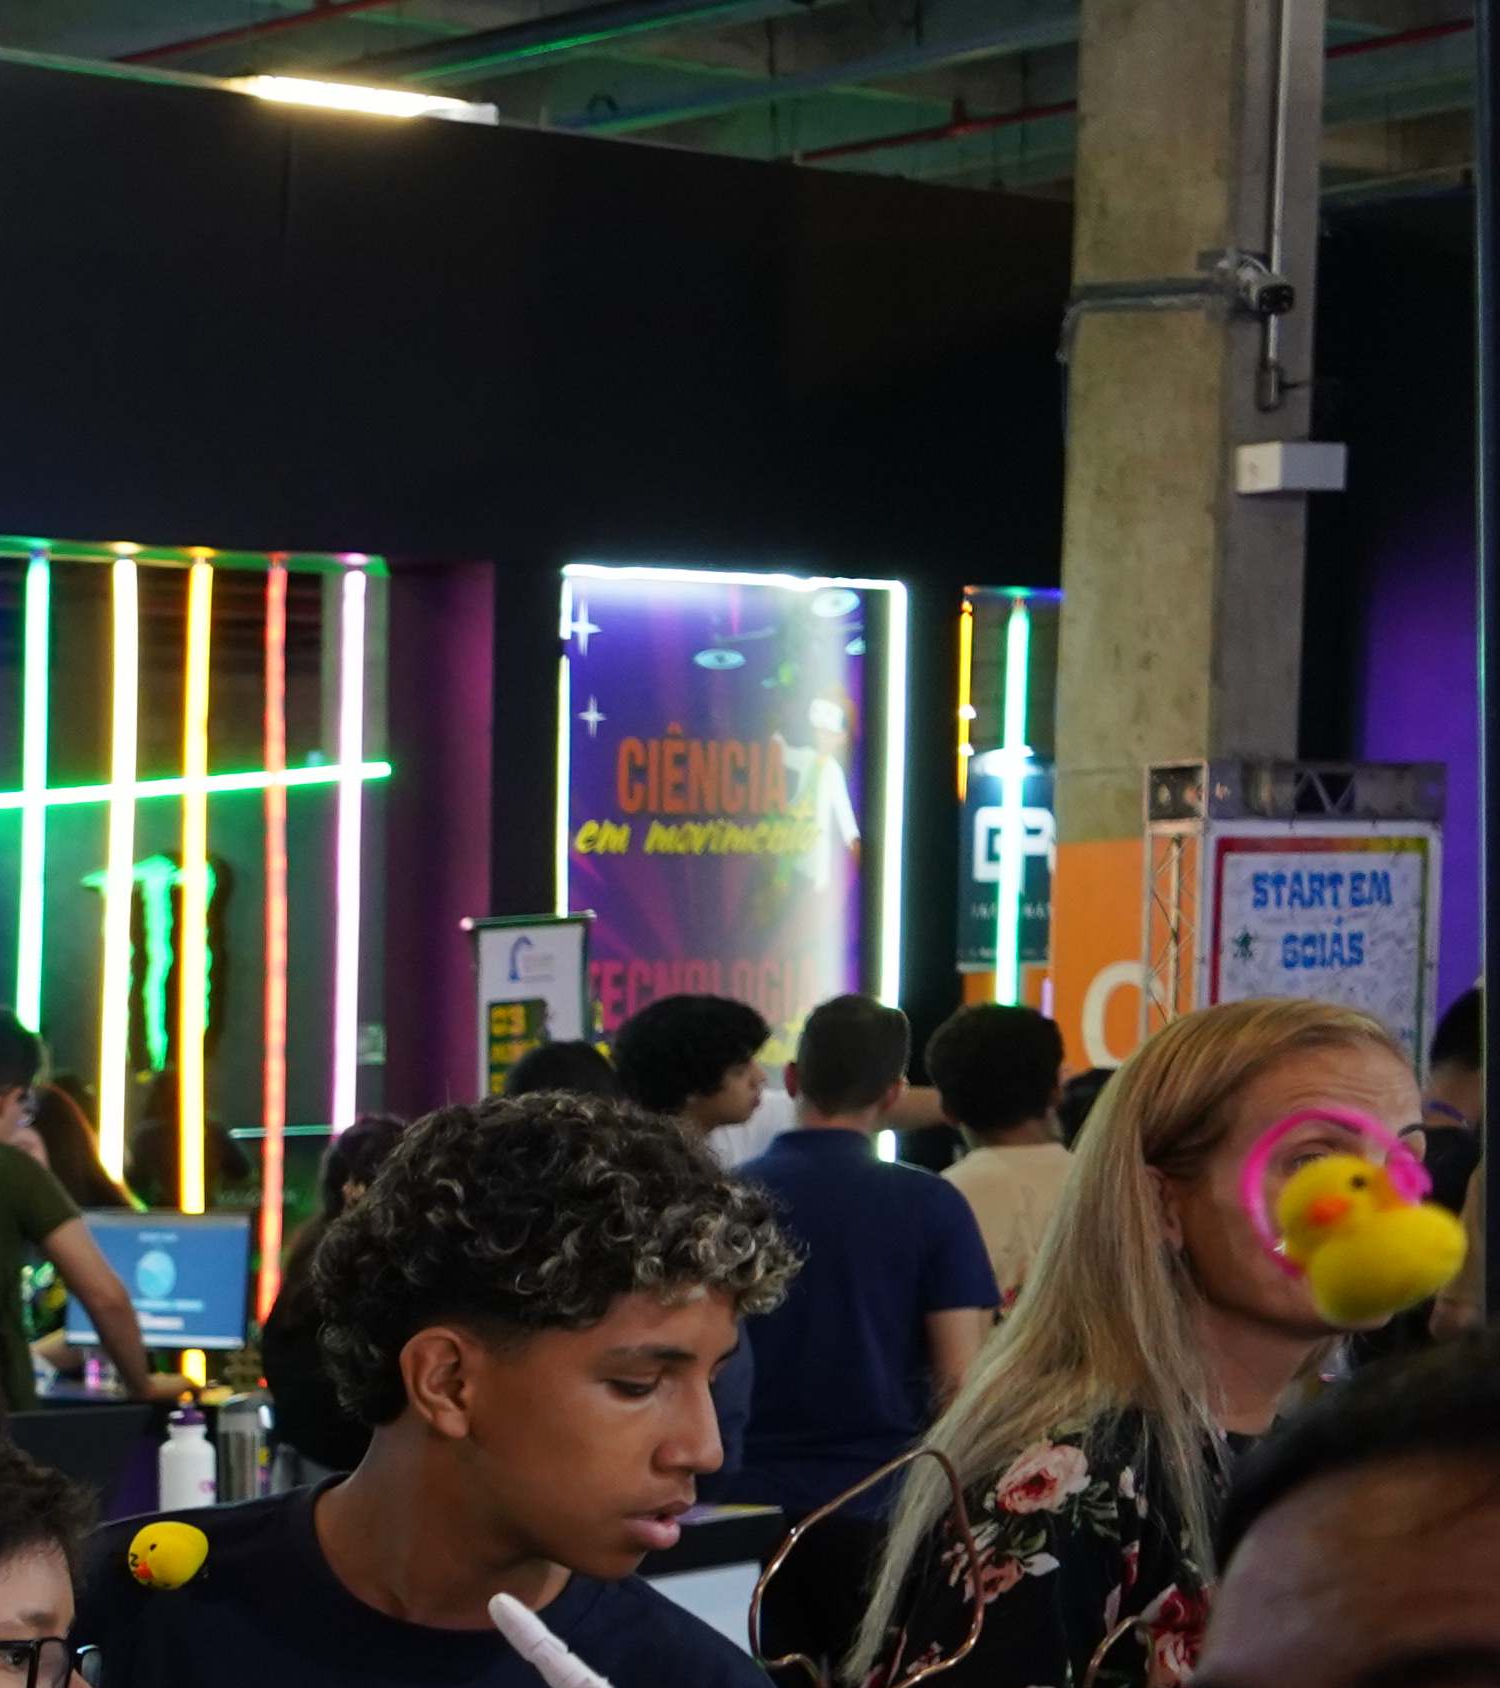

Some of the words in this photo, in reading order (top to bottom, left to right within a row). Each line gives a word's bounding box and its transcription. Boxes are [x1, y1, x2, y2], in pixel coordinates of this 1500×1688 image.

[616, 721, 789, 815] CIÊNCIA
[1252, 867, 1344, 909] START
[1348, 867, 1394, 908] EM
[1281, 915, 1365, 970] GOIÁS
